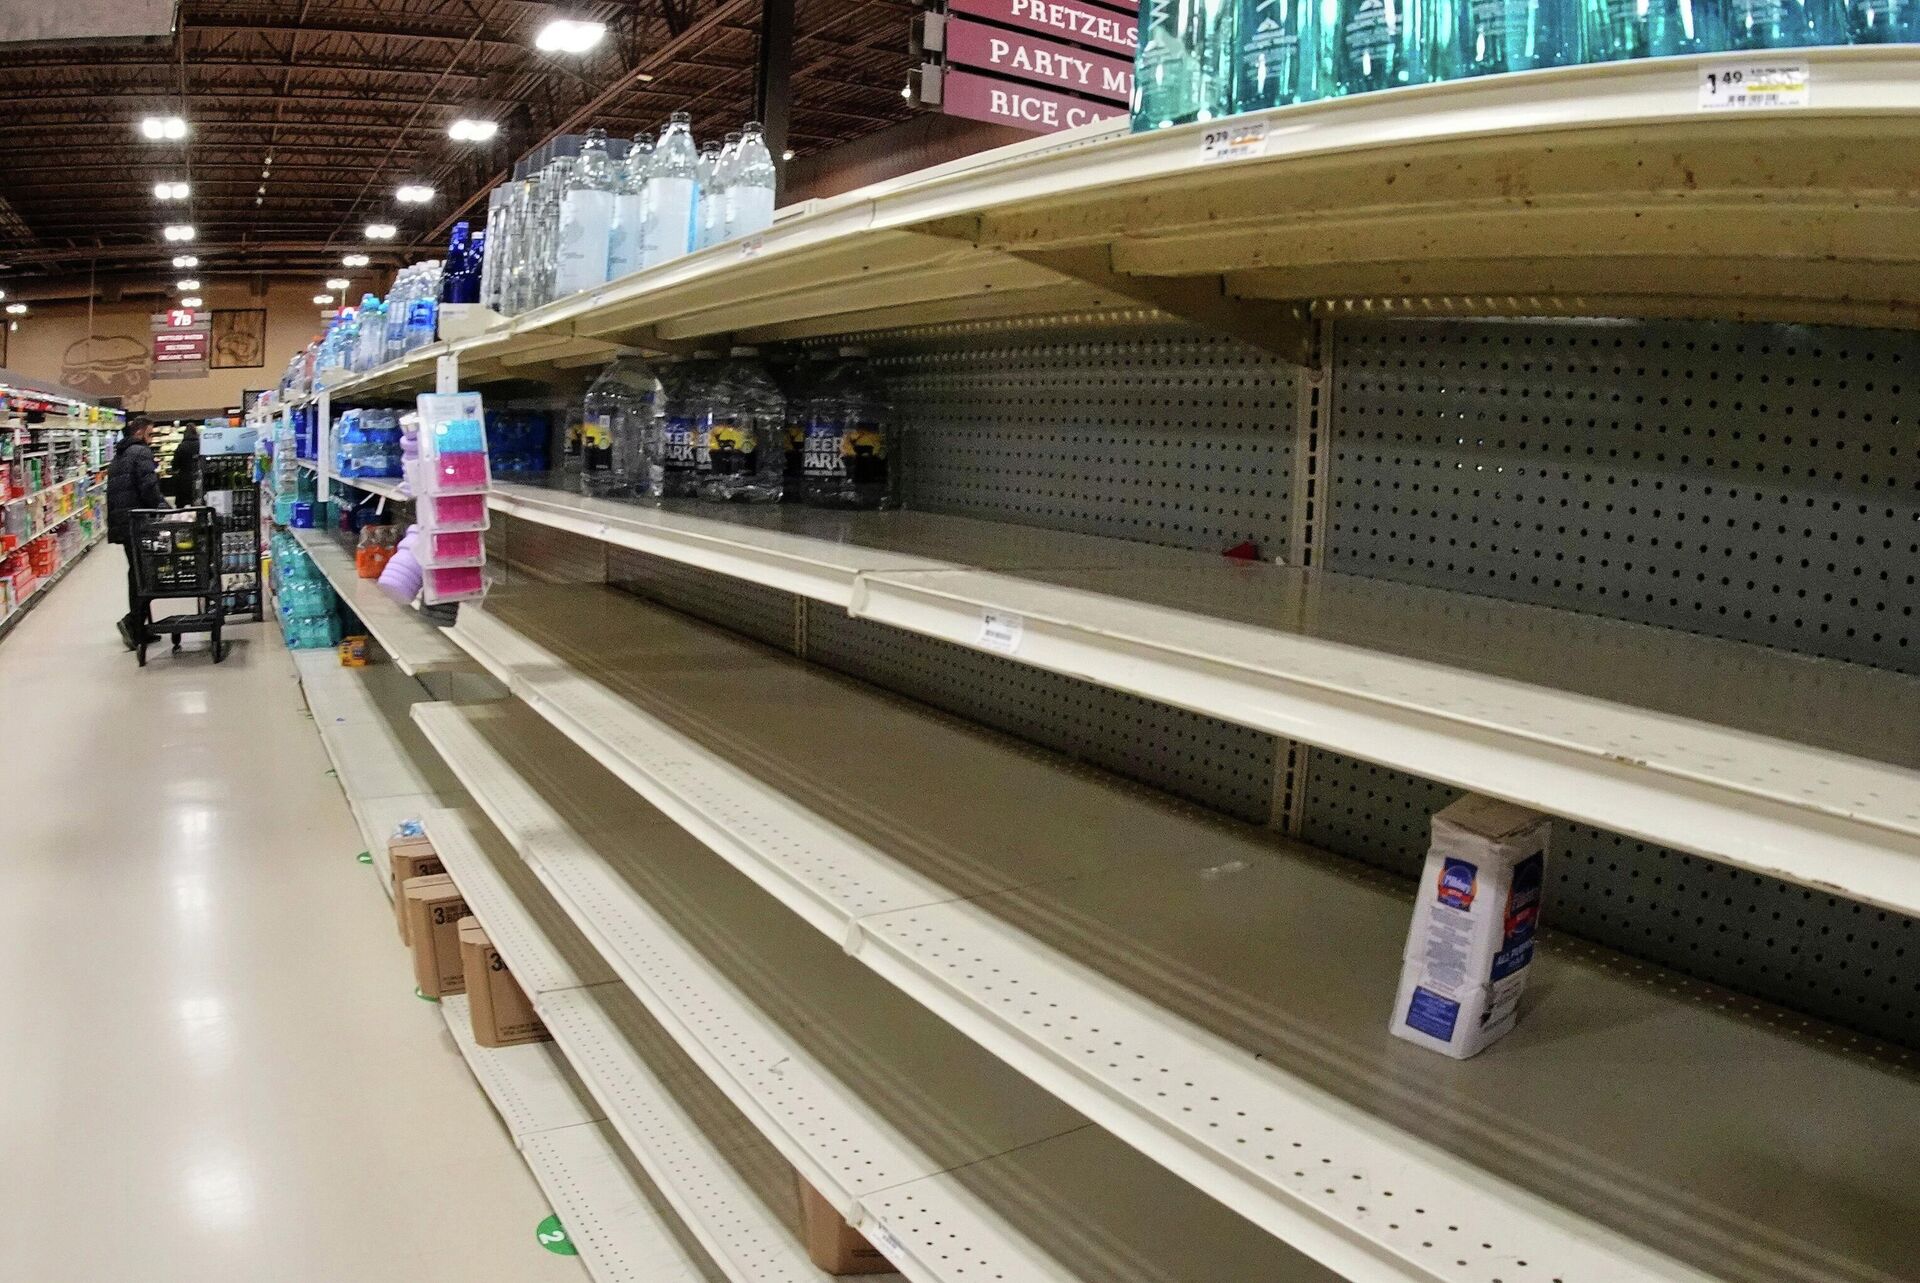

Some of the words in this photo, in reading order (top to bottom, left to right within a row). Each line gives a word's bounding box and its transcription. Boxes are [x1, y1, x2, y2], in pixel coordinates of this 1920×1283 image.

[1011, 0, 1139, 48] PRETZELS
[989, 38, 1094, 84] PARTY
[990, 89, 1059, 127] RICE
[804, 452, 847, 471] PARK
